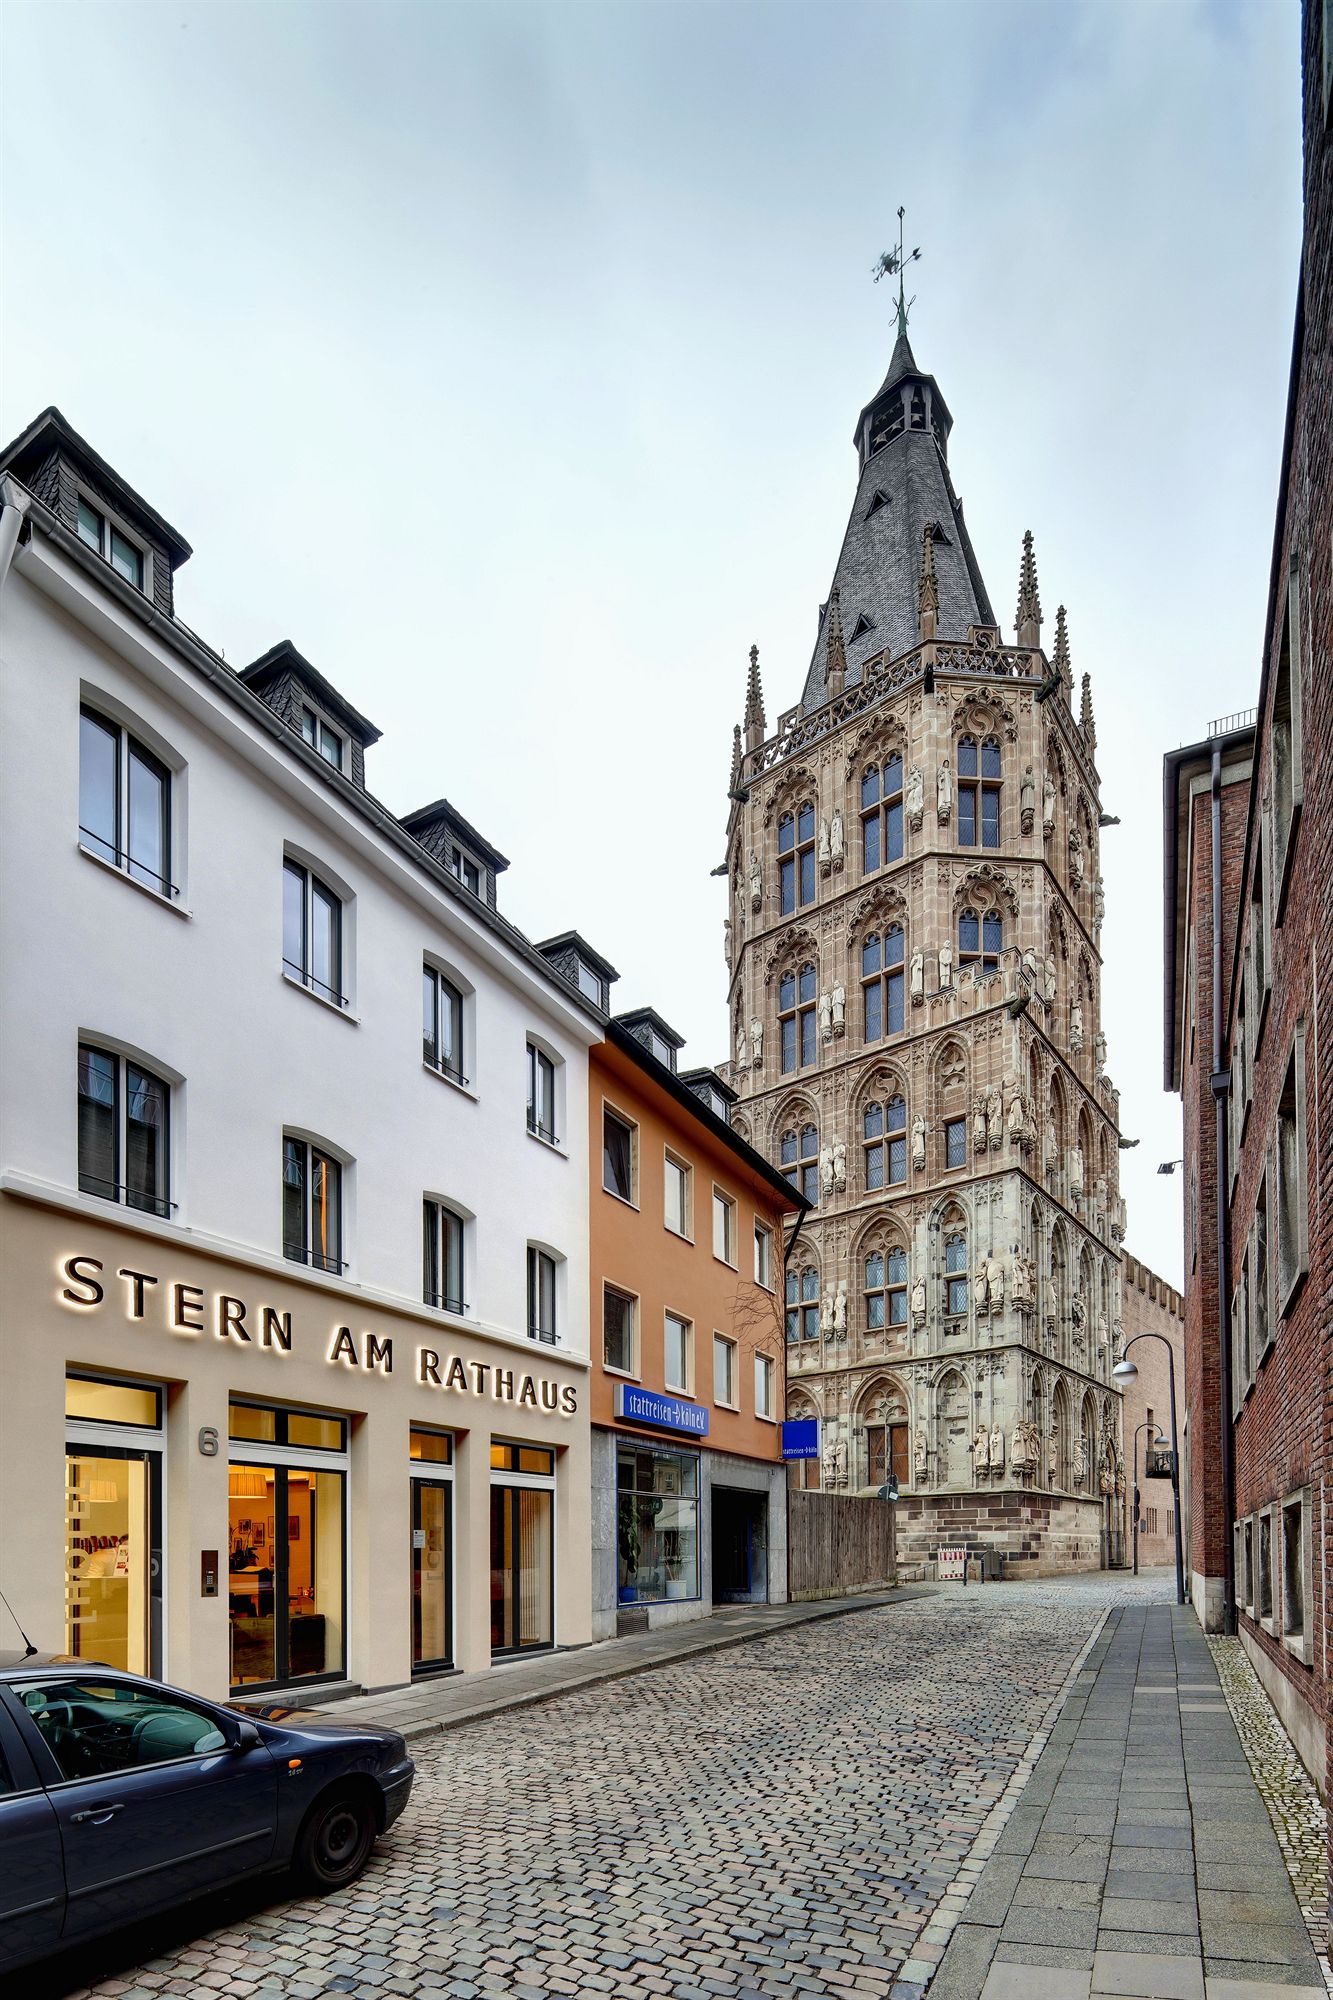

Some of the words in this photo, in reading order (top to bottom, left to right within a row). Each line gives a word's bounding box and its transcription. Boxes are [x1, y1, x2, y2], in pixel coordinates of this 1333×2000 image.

[63, 1256, 292, 1351] STERN
[330, 1326, 393, 1373] AM
[420, 1348, 578, 1414] RATHAUS
[629, 1394, 672, 1423] stattreisen
[198, 1426, 219, 1456] 6
